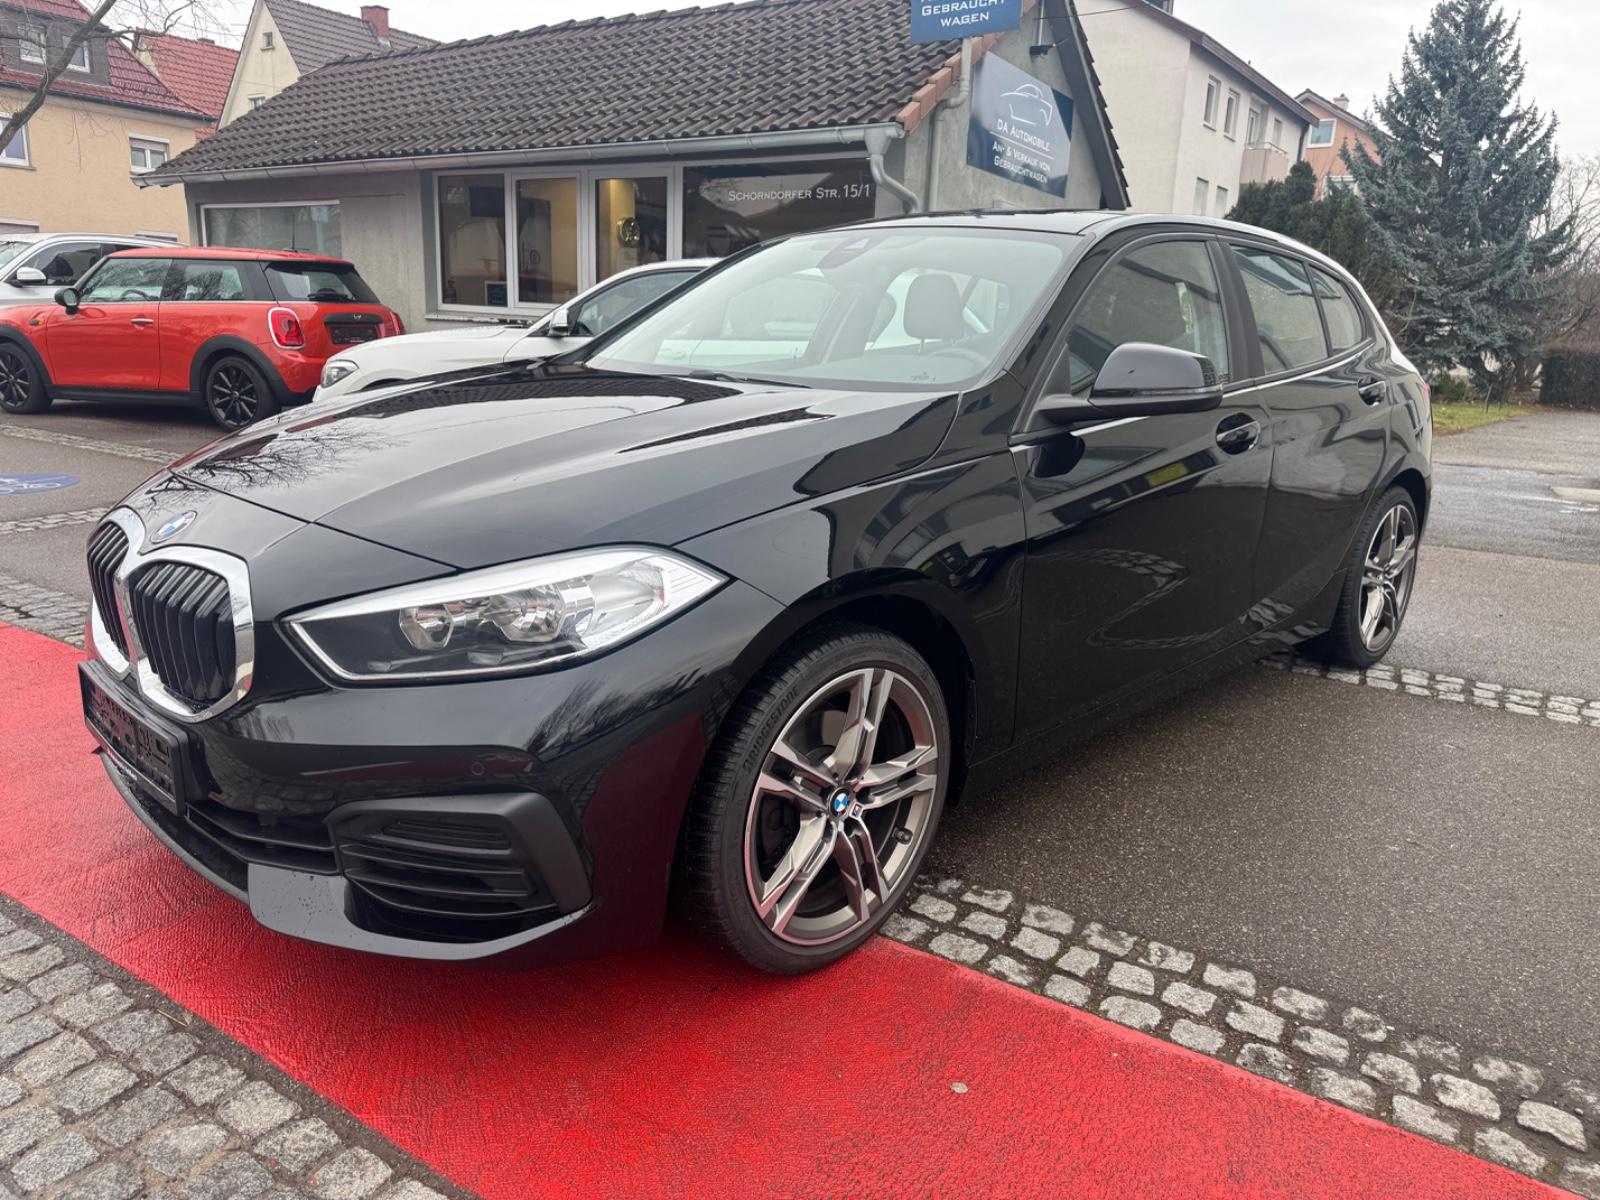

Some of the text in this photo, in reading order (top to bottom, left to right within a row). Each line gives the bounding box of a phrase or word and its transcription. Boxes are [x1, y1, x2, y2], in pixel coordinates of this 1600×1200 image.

[940, 12, 989, 27] WAGEN
[997, 118, 1008, 134] DA
[1006, 147, 1012, 157] &
[728, 184, 870, 201] SCHORNDORFER STR. 15/1
[743, 687, 800, 772] BRIDGESTONE
